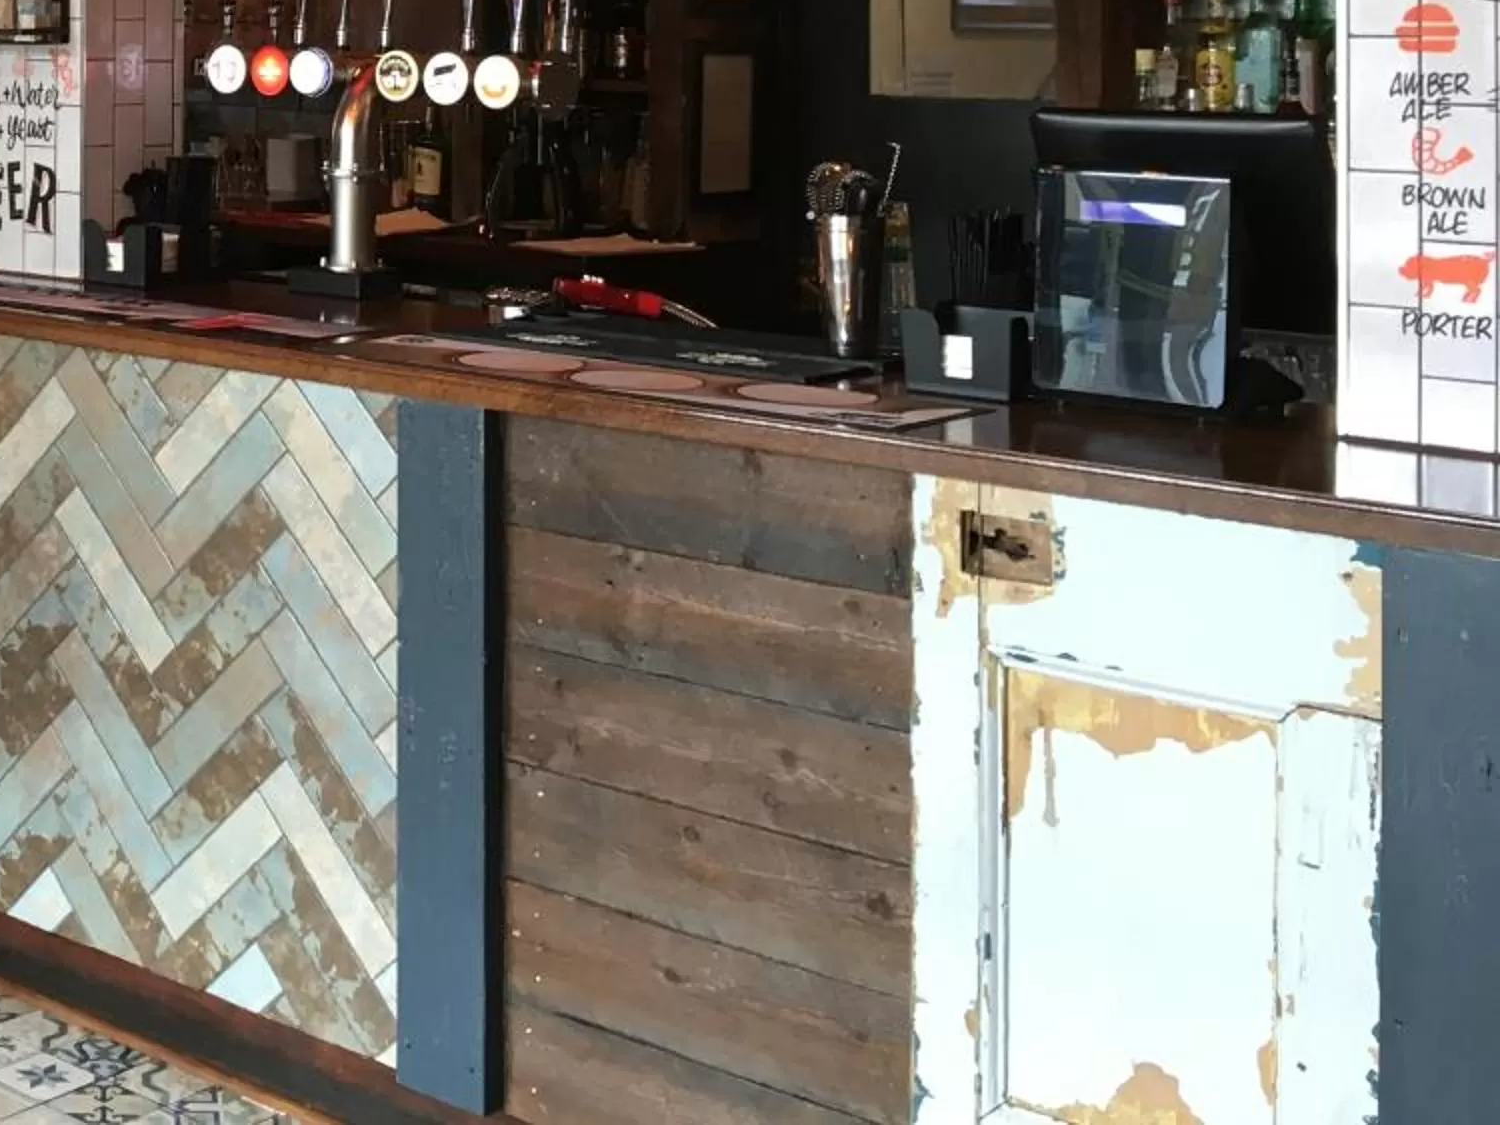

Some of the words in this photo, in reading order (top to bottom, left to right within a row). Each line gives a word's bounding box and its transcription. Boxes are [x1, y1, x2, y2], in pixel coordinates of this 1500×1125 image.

[12, 80, 61, 110] Water
[1389, 72, 1471, 99] AMBER
[1402, 98, 1452, 123] ALE
[1402, 184, 1487, 211] BROWN
[1426, 210, 1469, 236] ALE
[1401, 309, 1494, 340] PORTER
